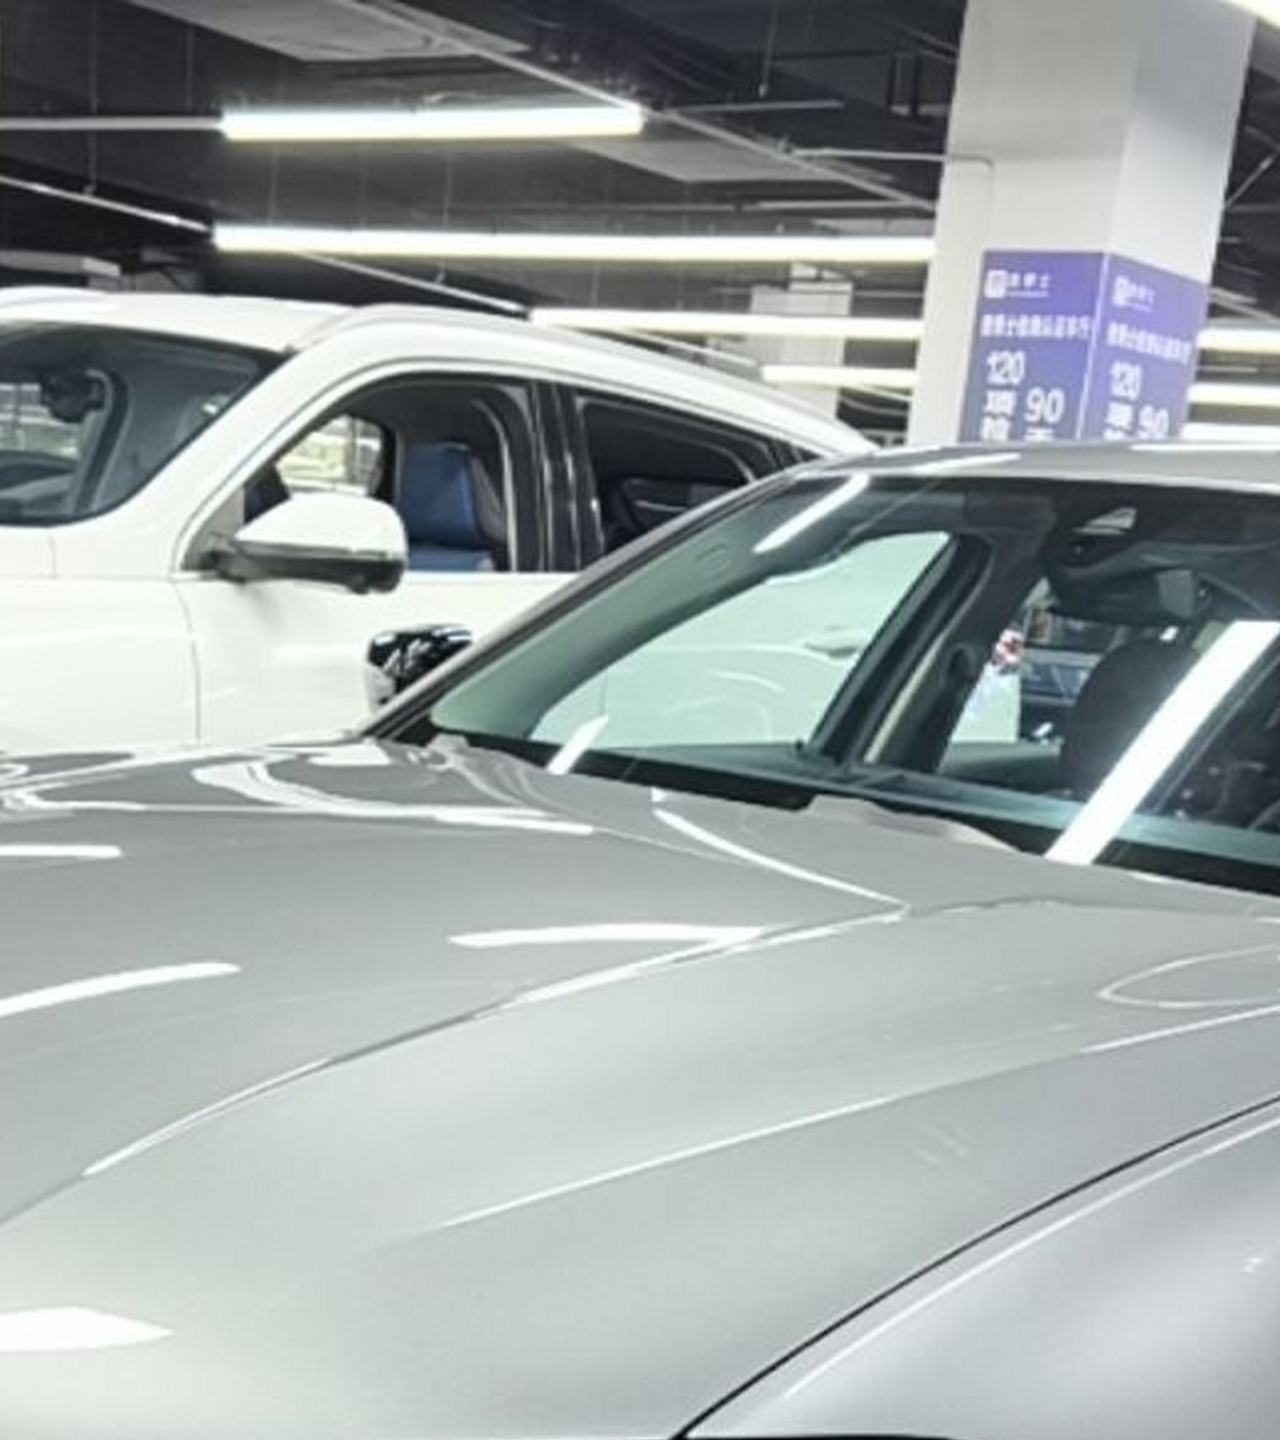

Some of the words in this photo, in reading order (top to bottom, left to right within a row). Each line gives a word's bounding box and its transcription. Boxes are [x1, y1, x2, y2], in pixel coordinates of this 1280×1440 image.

[986, 350, 1026, 385] 120
[1111, 361, 1142, 400] 120
[1023, 387, 1065, 425] 90
[1137, 404, 1170, 438] 90
